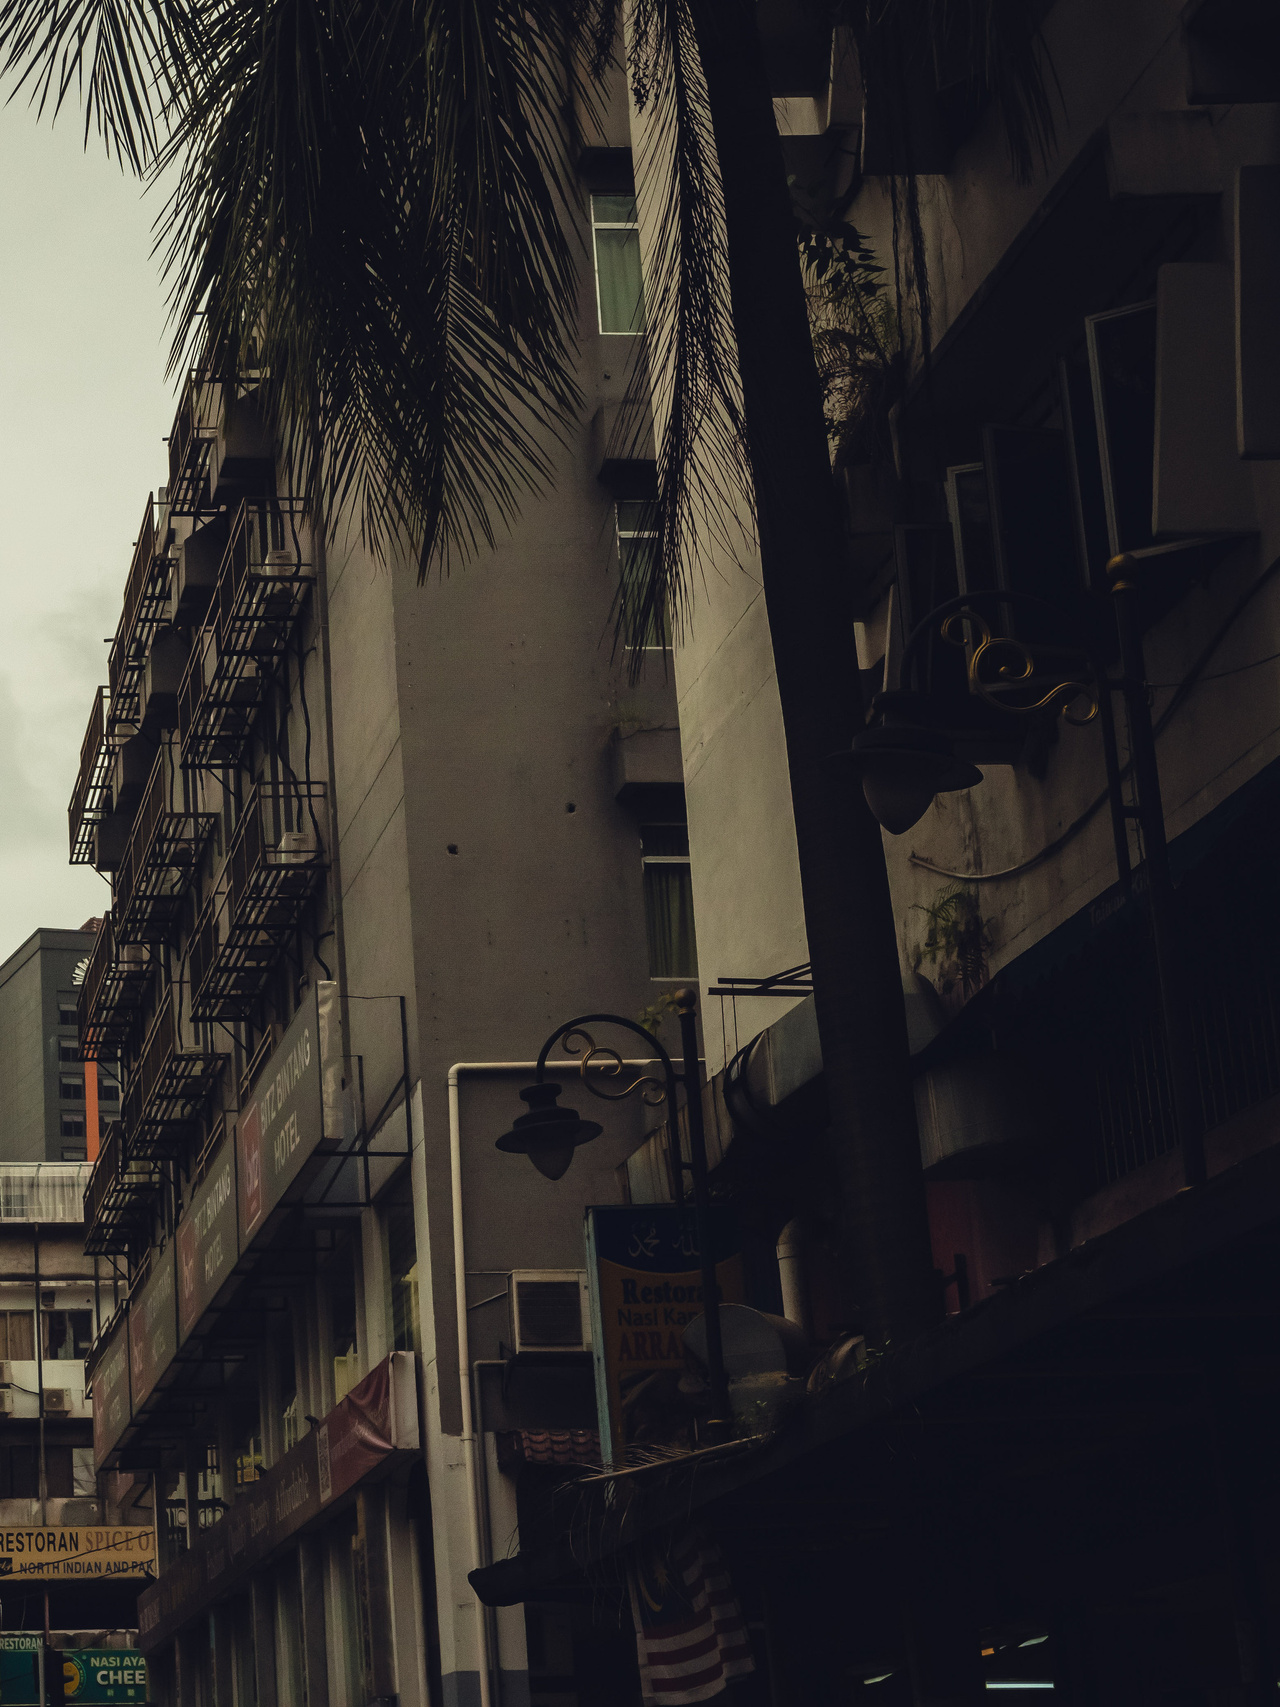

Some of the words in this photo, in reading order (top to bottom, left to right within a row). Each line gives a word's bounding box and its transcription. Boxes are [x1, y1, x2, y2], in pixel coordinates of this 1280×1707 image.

[260, 1081, 277, 1137] BITZ
[275, 1027, 311, 1112] BINTANG
[273, 1110, 300, 1175] HOTEL
[204, 1231, 224, 1284] HOTEL
[85, 1530, 134, 1552] SPICE
[138, 1530, 157, 1552] O
[19, 1562, 60, 1574] NORTH
[63, 1562, 102, 1574] INDIAN
[105, 1561, 130, 1573] AND
[0, 1637, 44, 1650] RESTORAN
[90, 1656, 121, 1668] NASI
